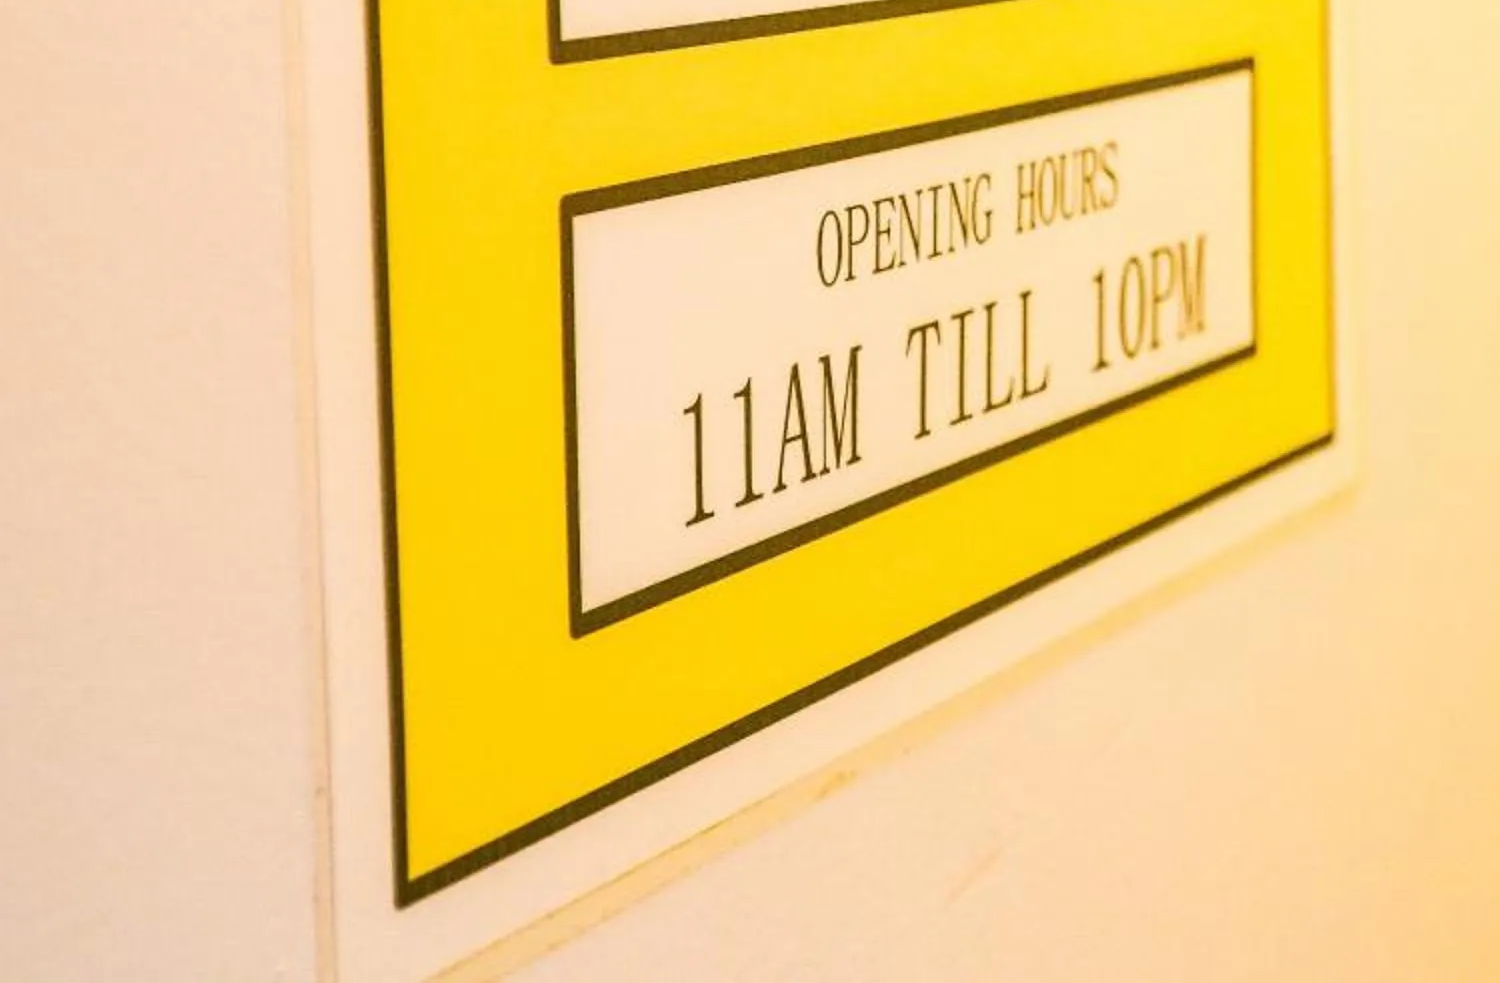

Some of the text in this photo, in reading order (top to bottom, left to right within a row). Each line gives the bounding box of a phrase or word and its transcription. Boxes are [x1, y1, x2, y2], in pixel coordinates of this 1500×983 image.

[815, 140, 1119, 288] OPENING HOURS
[682, 232, 1208, 528] 11AM TILL 10PM
